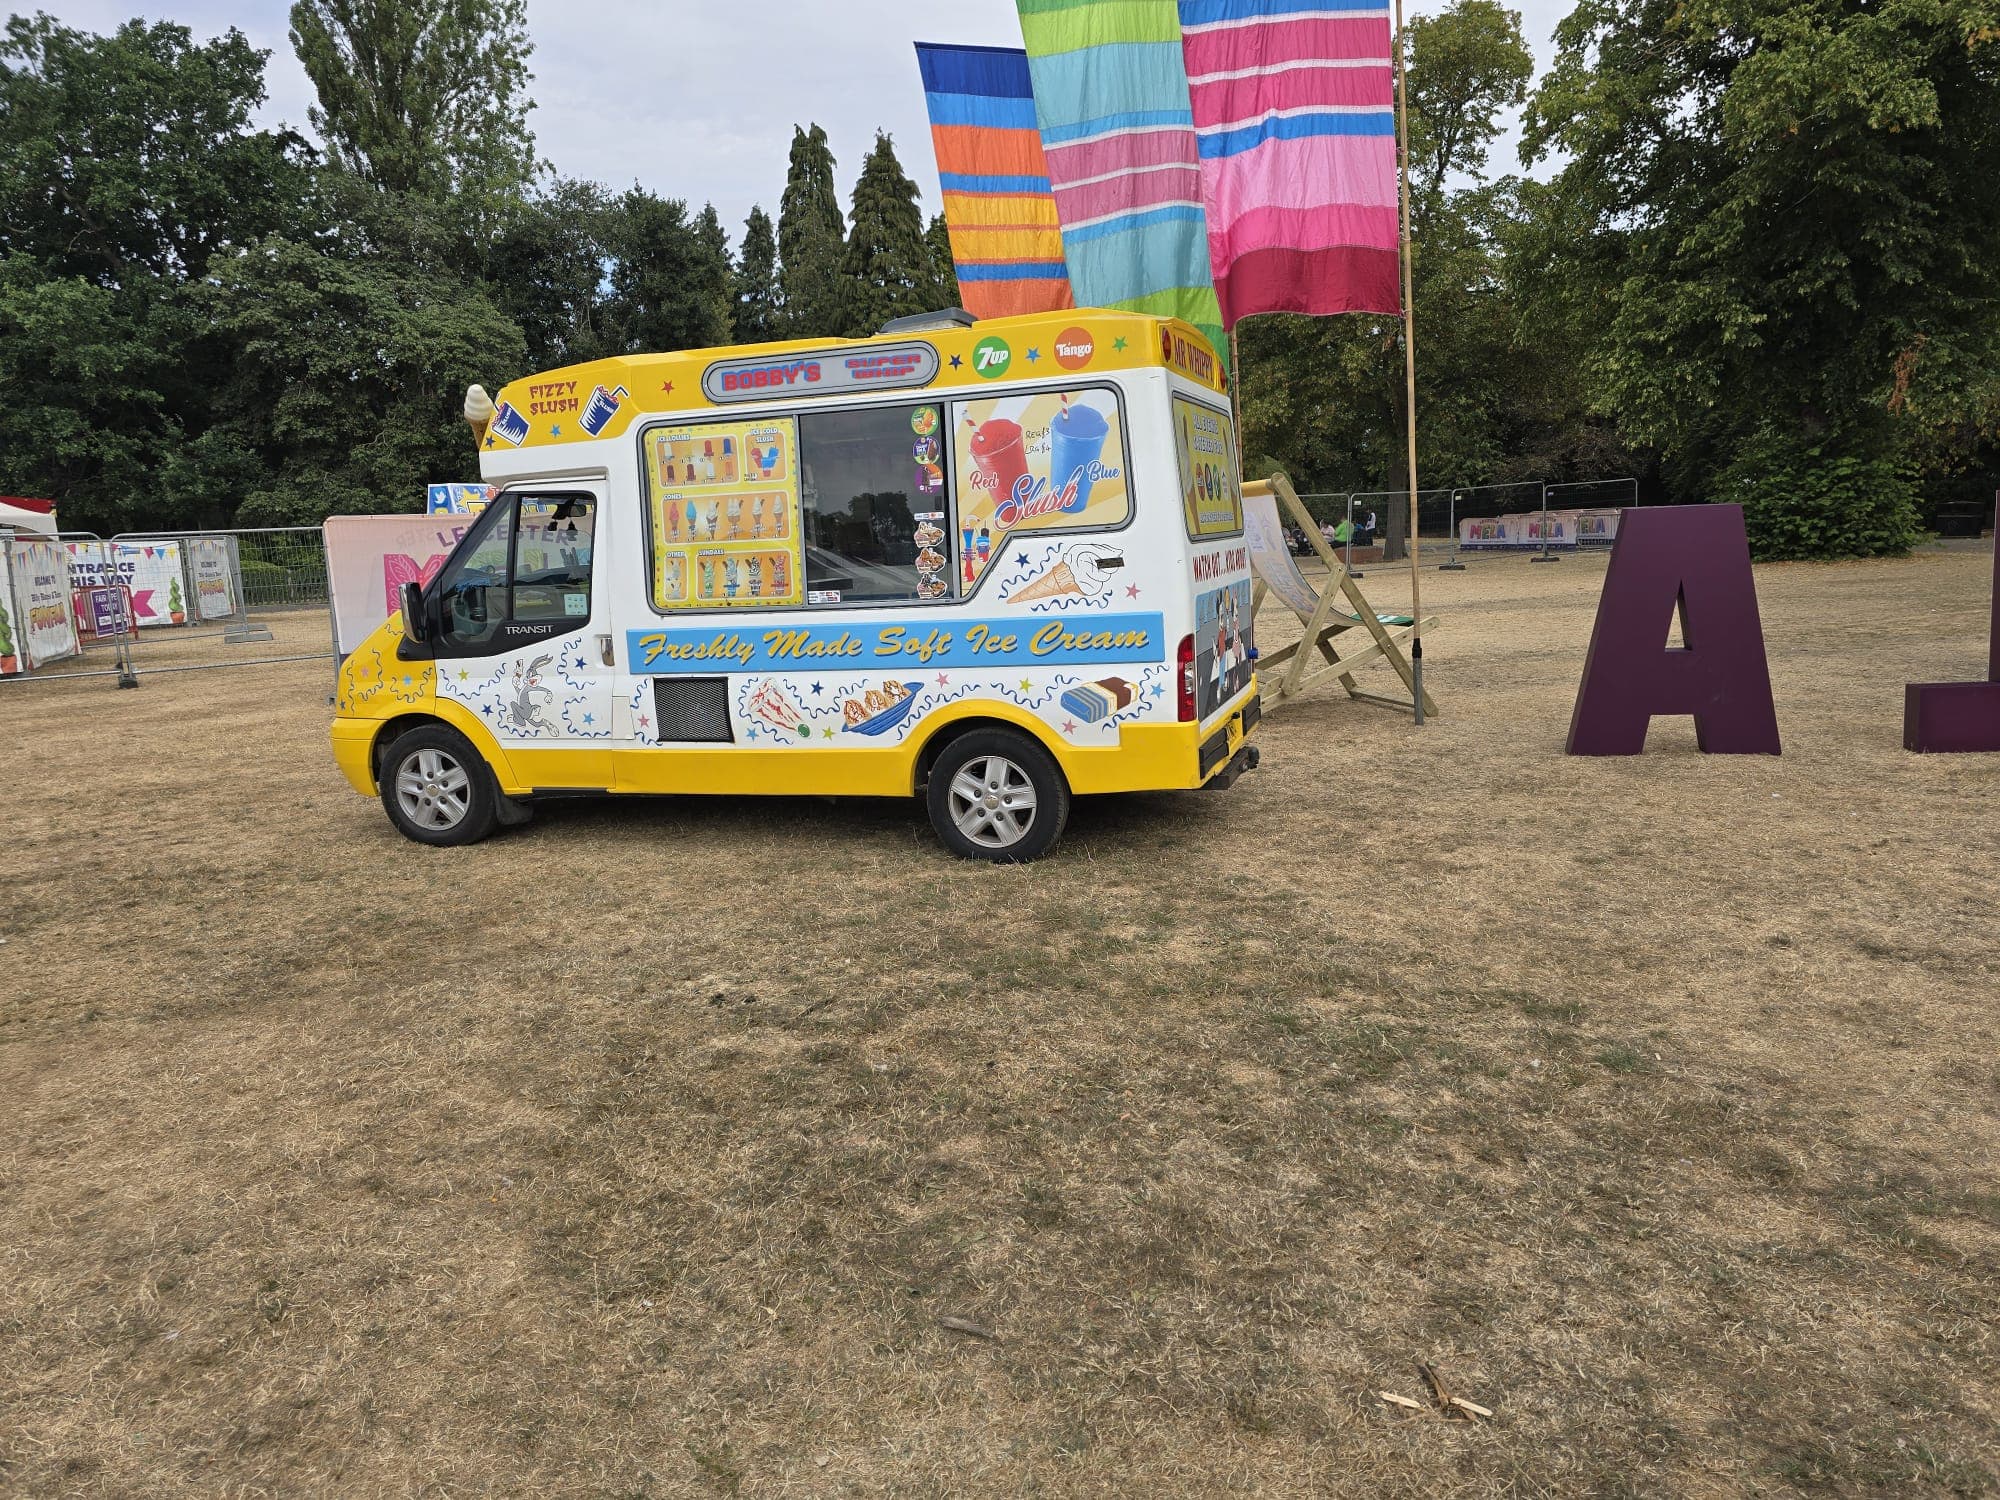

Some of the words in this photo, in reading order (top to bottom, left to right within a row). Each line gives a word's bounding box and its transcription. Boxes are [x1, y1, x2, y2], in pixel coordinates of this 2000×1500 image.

[1056, 342, 1093, 357] Tango
[1173, 334, 1186, 369] MR
[1187, 341, 1213, 382] WHIPPY
[721, 361, 821, 391] BOBBY'S
[845, 353, 922, 369] SUPER
[529, 381, 577, 399] FIZZY
[530, 398, 579, 416] SLUSH
[1086, 460, 1120, 482] Blue
[970, 471, 999, 490] Red
[994, 465, 1083, 530] Slush
[1469, 524, 1506, 539] MELA
[1580, 516, 1605, 534] ELA
[70, 575, 97, 588] HIS
[505, 624, 553, 634] TRANSIT
[639, 633, 755, 666] Freshly
[763, 630, 863, 659] Made
[874, 626, 953, 663] Soft
[966, 624, 1018, 654] Ice
[1029, 620, 1150, 656] Cream
